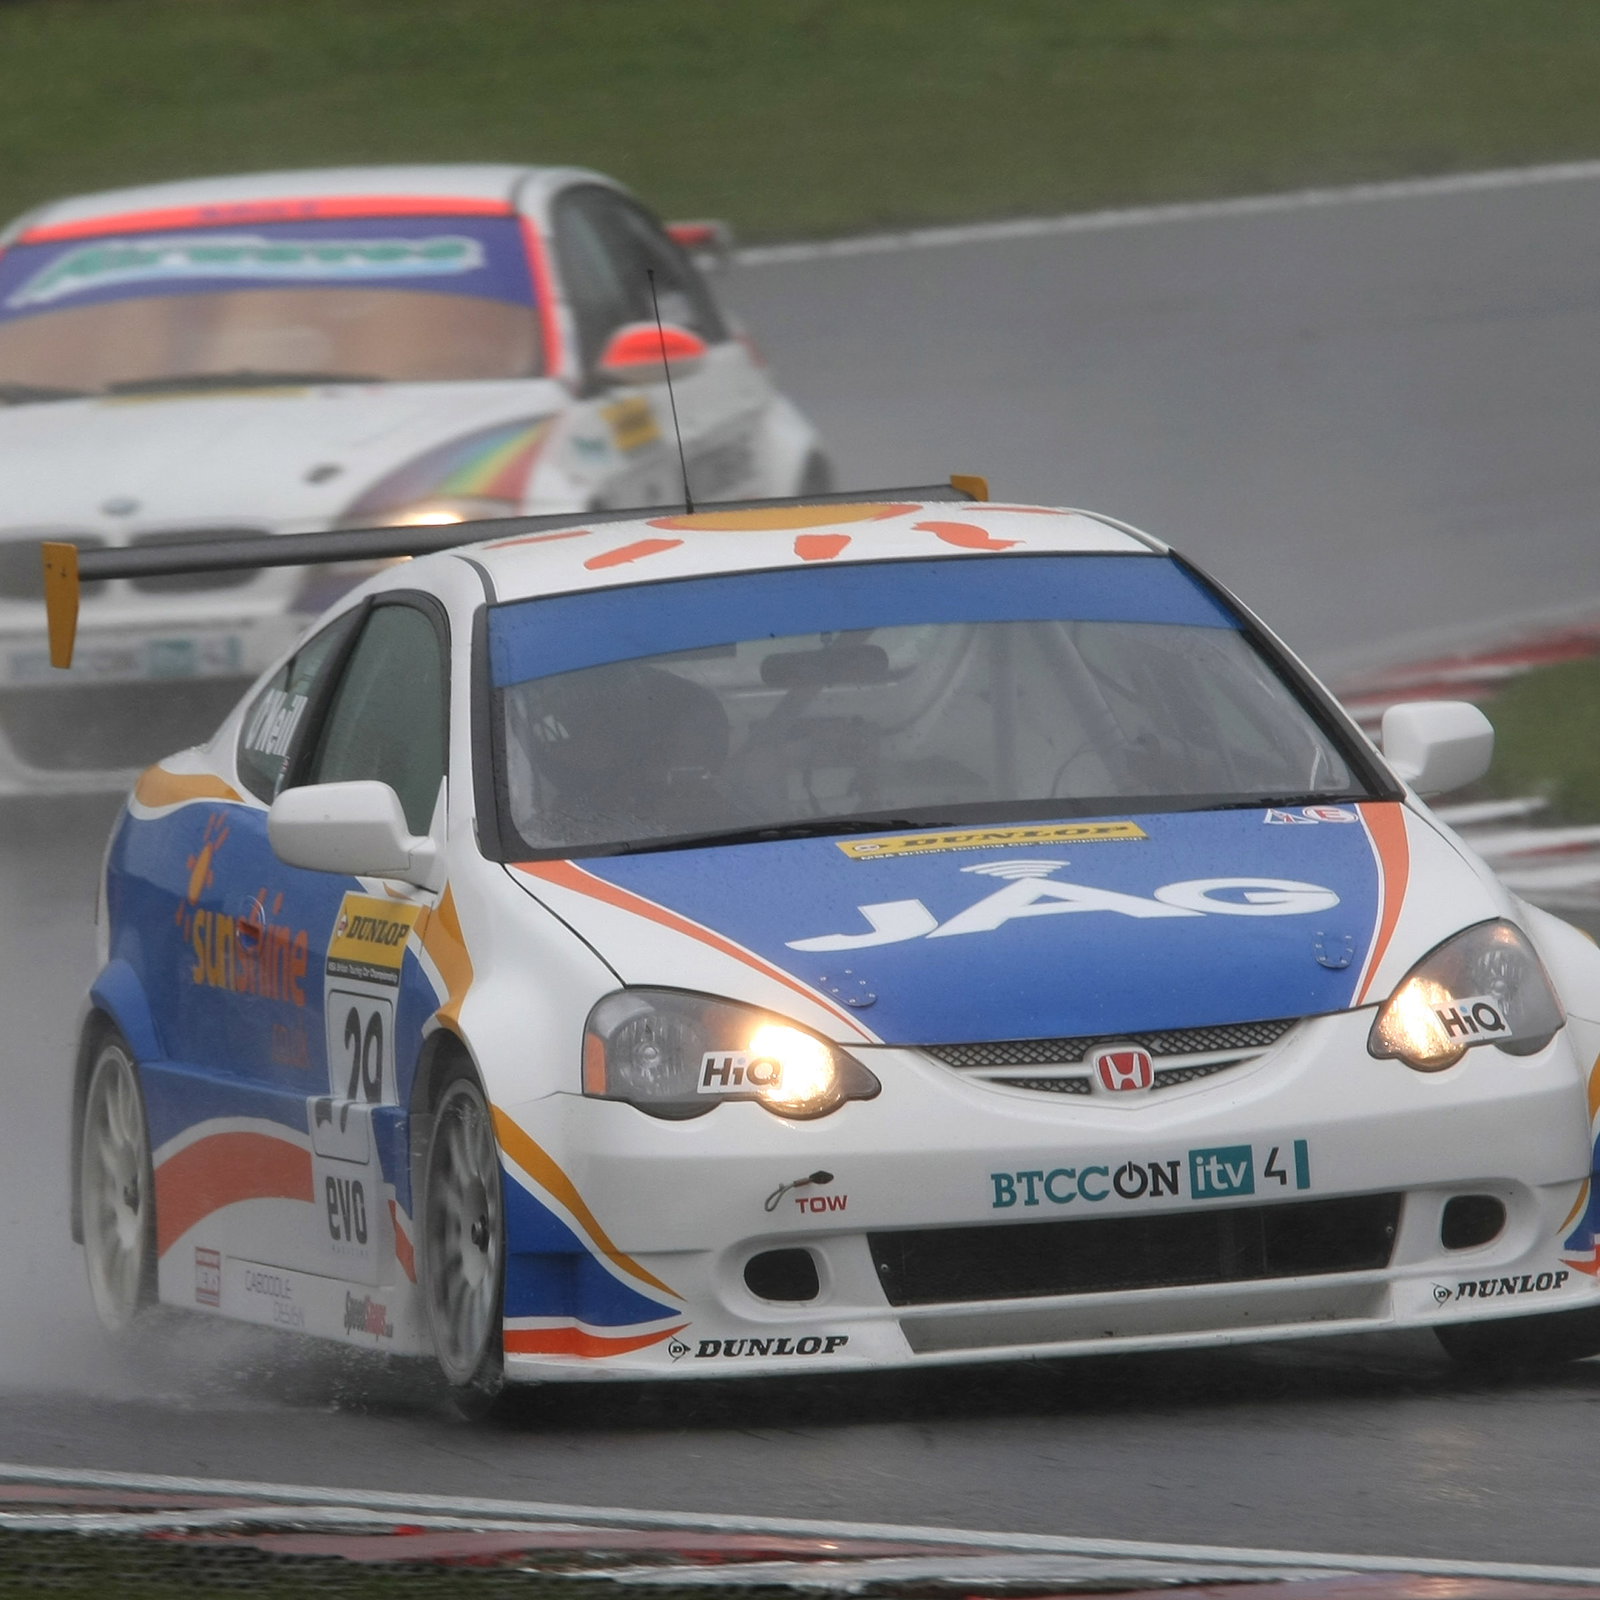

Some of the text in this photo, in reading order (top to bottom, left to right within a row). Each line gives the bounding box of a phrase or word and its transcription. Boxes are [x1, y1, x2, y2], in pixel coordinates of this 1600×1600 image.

[903, 825, 1128, 847] DUNLOP
[785, 877, 1341, 952] JAG
[346, 915, 410, 947] DUNLOP
[1436, 1002, 1506, 1038] HiQ
[703, 1057, 781, 1087] HiQ
[1196, 1157, 1248, 1192] itv
[325, 1175, 368, 1245] evo
[795, 1195, 848, 1214] TOW
[1455, 1270, 1570, 1301] DUNLOP
[694, 1335, 849, 1359] DUNLOP
